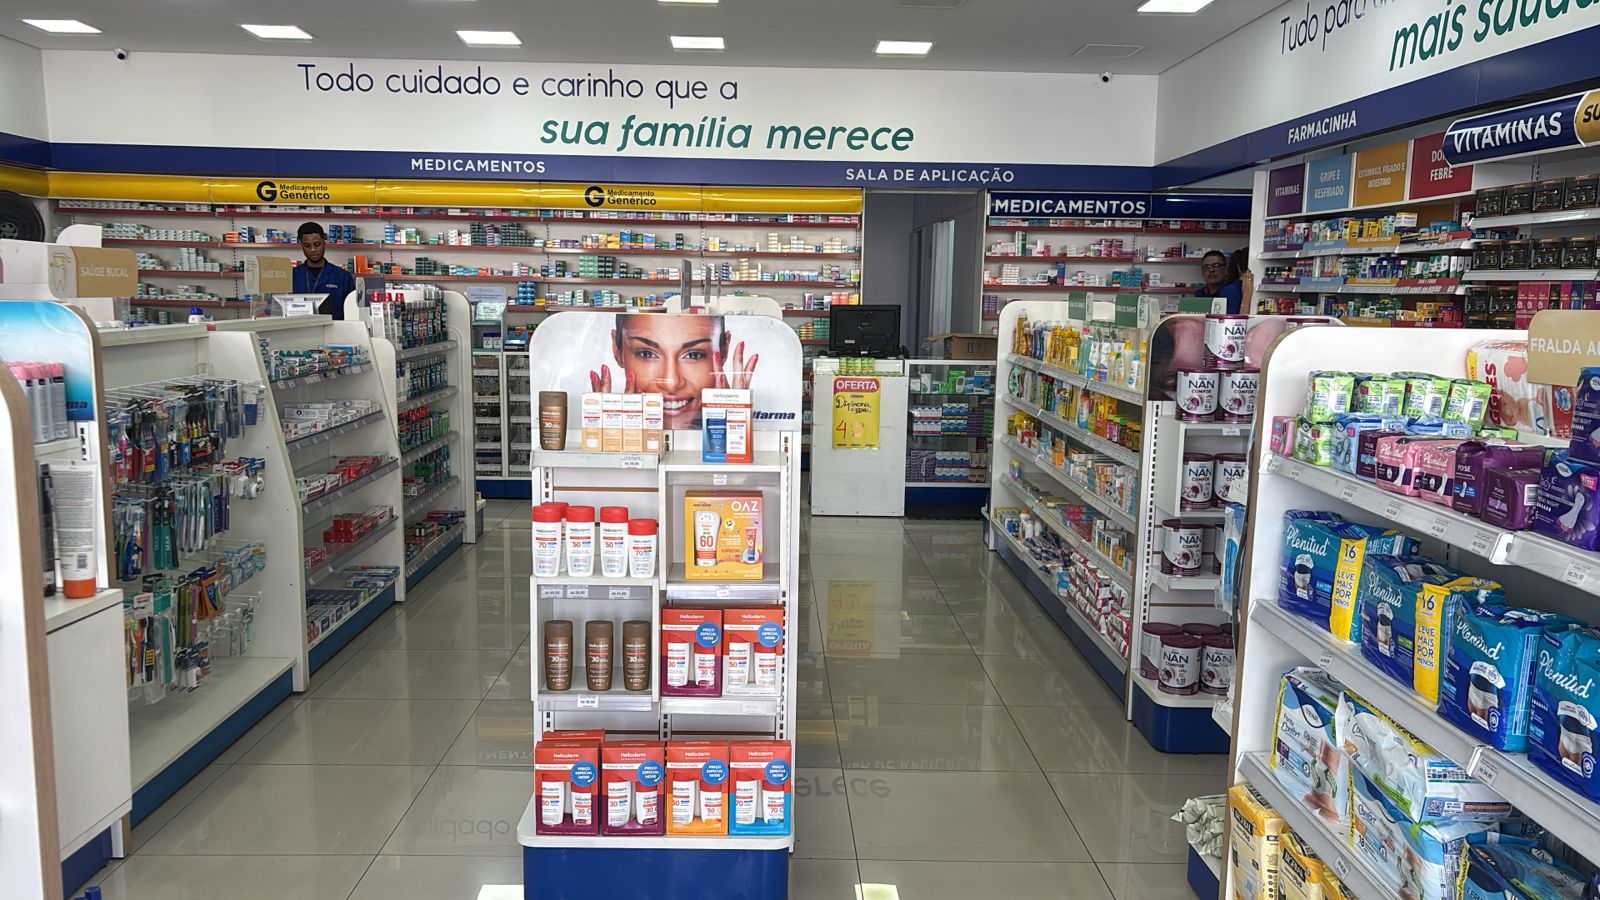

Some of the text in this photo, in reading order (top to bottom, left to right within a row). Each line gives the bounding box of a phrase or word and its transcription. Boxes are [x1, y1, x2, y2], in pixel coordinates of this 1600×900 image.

[1281, 2, 1318, 54] Tudo
[1389, 0, 1466, 71] mais
[297, 63, 738, 108] Todo cuidado e carinho que a
[540, 114, 914, 152] sua família merece
[1288, 110, 1356, 145] FARMACINHA
[1454, 112, 1562, 153] VITAMINAS
[411, 158, 546, 174] MEDICAMENTOS
[846, 167, 1014, 184] SALA DE APLICAÇÃO
[1320, 169, 1341, 183] GRIPE E
[1430, 168, 1453, 182] FEBRE
[280, 184, 328, 192] Medicamento
[607, 189, 655, 197] Medicamento
[1275, 184, 1300, 197] VITAMINAS
[1314, 186, 1344, 198] RESFRIADO
[280, 190, 330, 201] Genérico
[607, 195, 657, 206] Genérico
[995, 199, 1146, 214] MEDICAMENTOS
[80, 264, 105, 277] SAÚDE
[1531, 338, 1581, 354] FRALDA
[836, 380, 878, 390] OFERTA
[1188, 380, 1215, 389] NAN
[1231, 380, 1258, 389] NAN
[1423, 452, 1448, 467] Plenitud
[1457, 465, 1471, 473] POISE
[700, 535, 714, 547] 60
[1286, 525, 1328, 557] Plenitud
[1345, 544, 1356, 559] 16
[1337, 571, 1355, 581] LEVE
[1336, 581, 1353, 590] MAIS
[1368, 571, 1403, 608] Plenitud
[1335, 589, 1351, 600] POR
[1334, 598, 1350, 607] MENOS
[1422, 594, 1435, 611] 16
[1418, 625, 1435, 637] LEVE
[1456, 616, 1501, 660] Plenitud
[1417, 636, 1434, 646] MAIS
[1163, 653, 1189, 664] NAN
[1417, 645, 1434, 659] POR
[1416, 656, 1434, 668] MENOS
[1539, 650, 1591, 699] Plenitud
[1281, 721, 1300, 739] Confort
[1357, 804, 1377, 825] Confort
